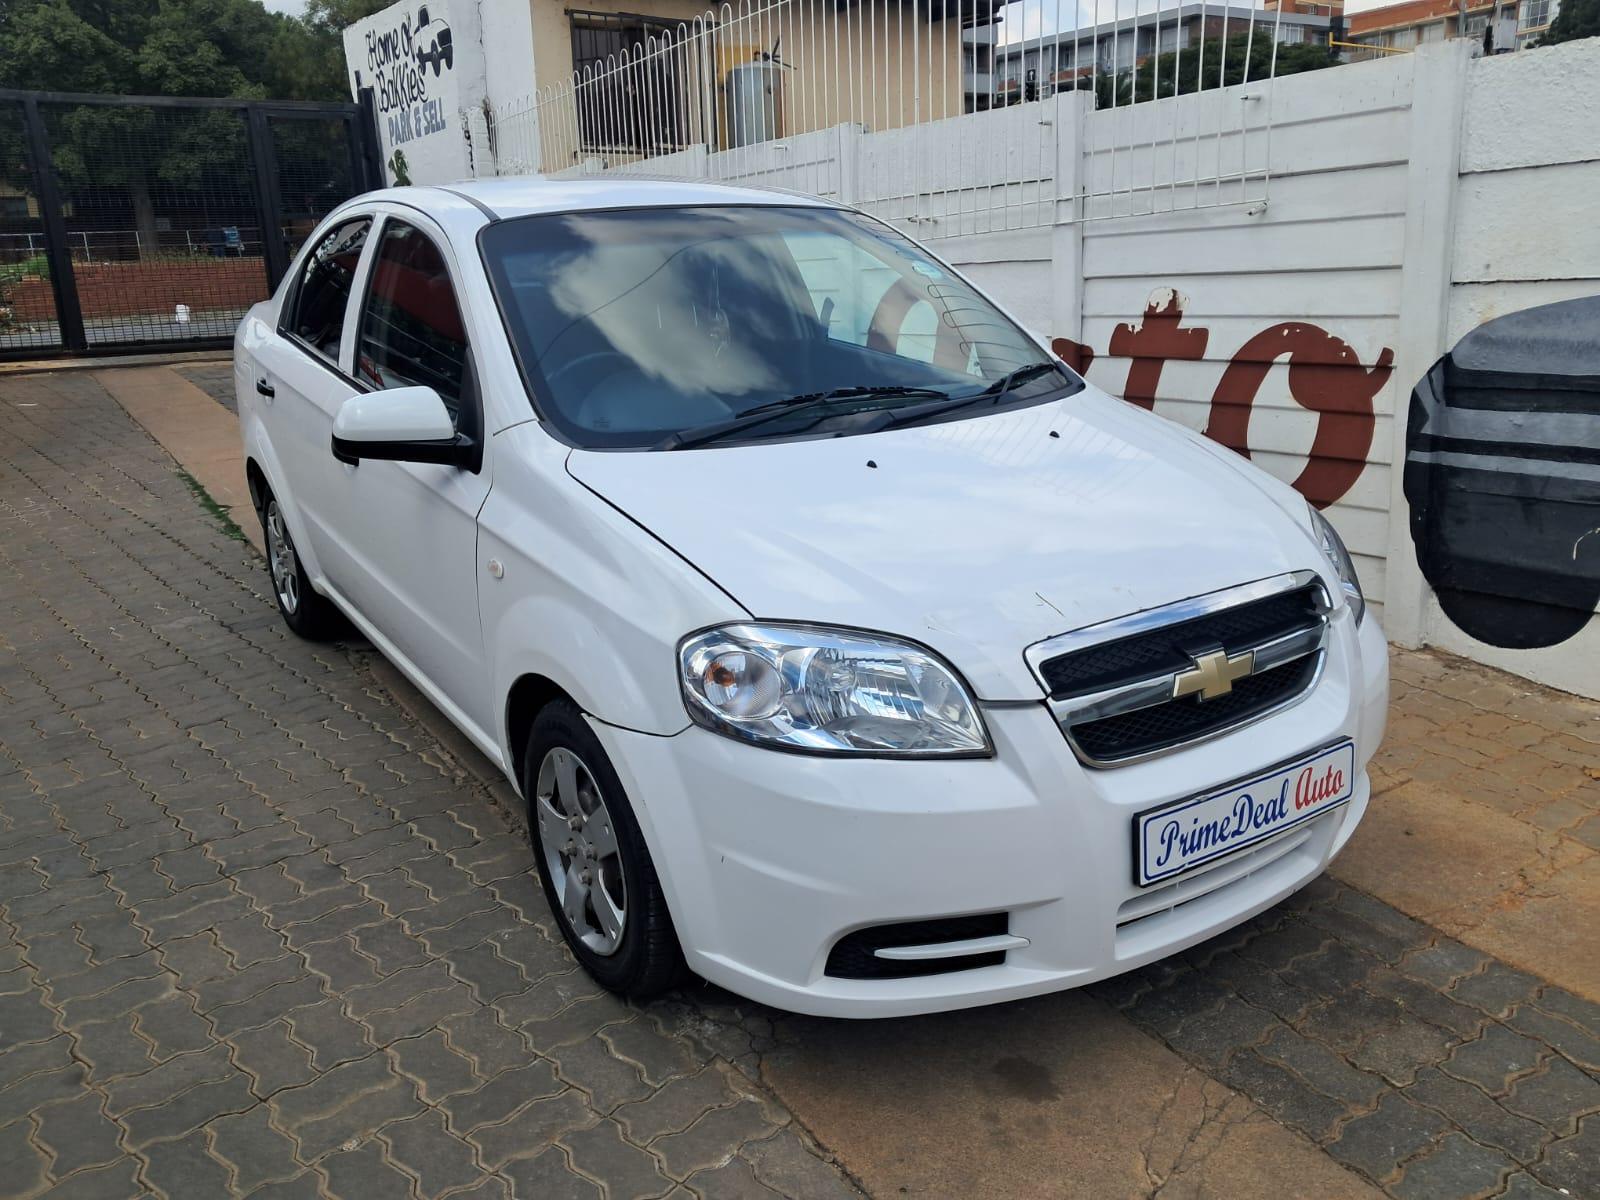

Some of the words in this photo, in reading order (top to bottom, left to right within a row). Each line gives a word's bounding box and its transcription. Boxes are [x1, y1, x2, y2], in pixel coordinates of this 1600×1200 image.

[366, 29, 400, 71] Home
[401, 11, 416, 62] of
[388, 110, 414, 146] PARK
[414, 106, 422, 137] &
[424, 98, 446, 135] SELL
[1157, 778, 1289, 866] PrimeDeal
[1295, 764, 1344, 811] Auto
